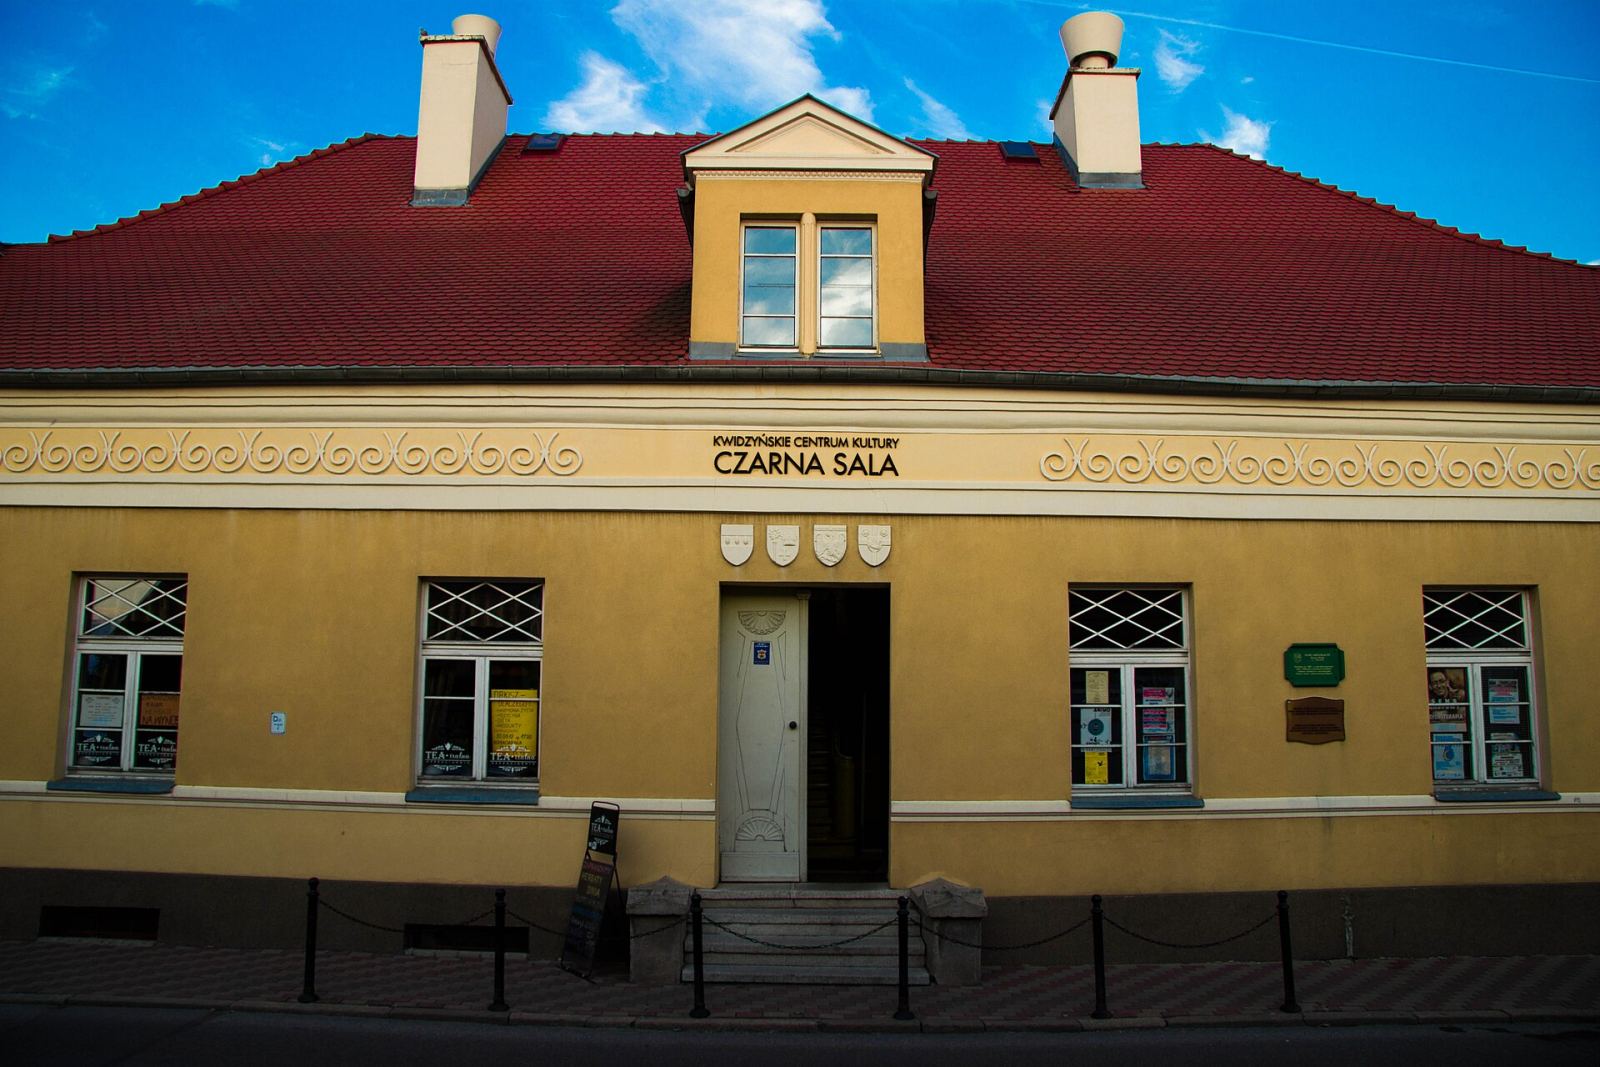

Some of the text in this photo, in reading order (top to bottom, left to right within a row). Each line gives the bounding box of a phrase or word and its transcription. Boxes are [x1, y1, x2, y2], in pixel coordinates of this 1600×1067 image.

[713, 433, 900, 449] KWIDZYŃSKIE CENTRUM KULTURY
[714, 451, 899, 477] CZARNA SALA
[77, 743, 96, 751] TEA
[138, 743, 157, 752] TEA
[425, 751, 446, 759] TEA
[490, 752, 510, 761] TEA
